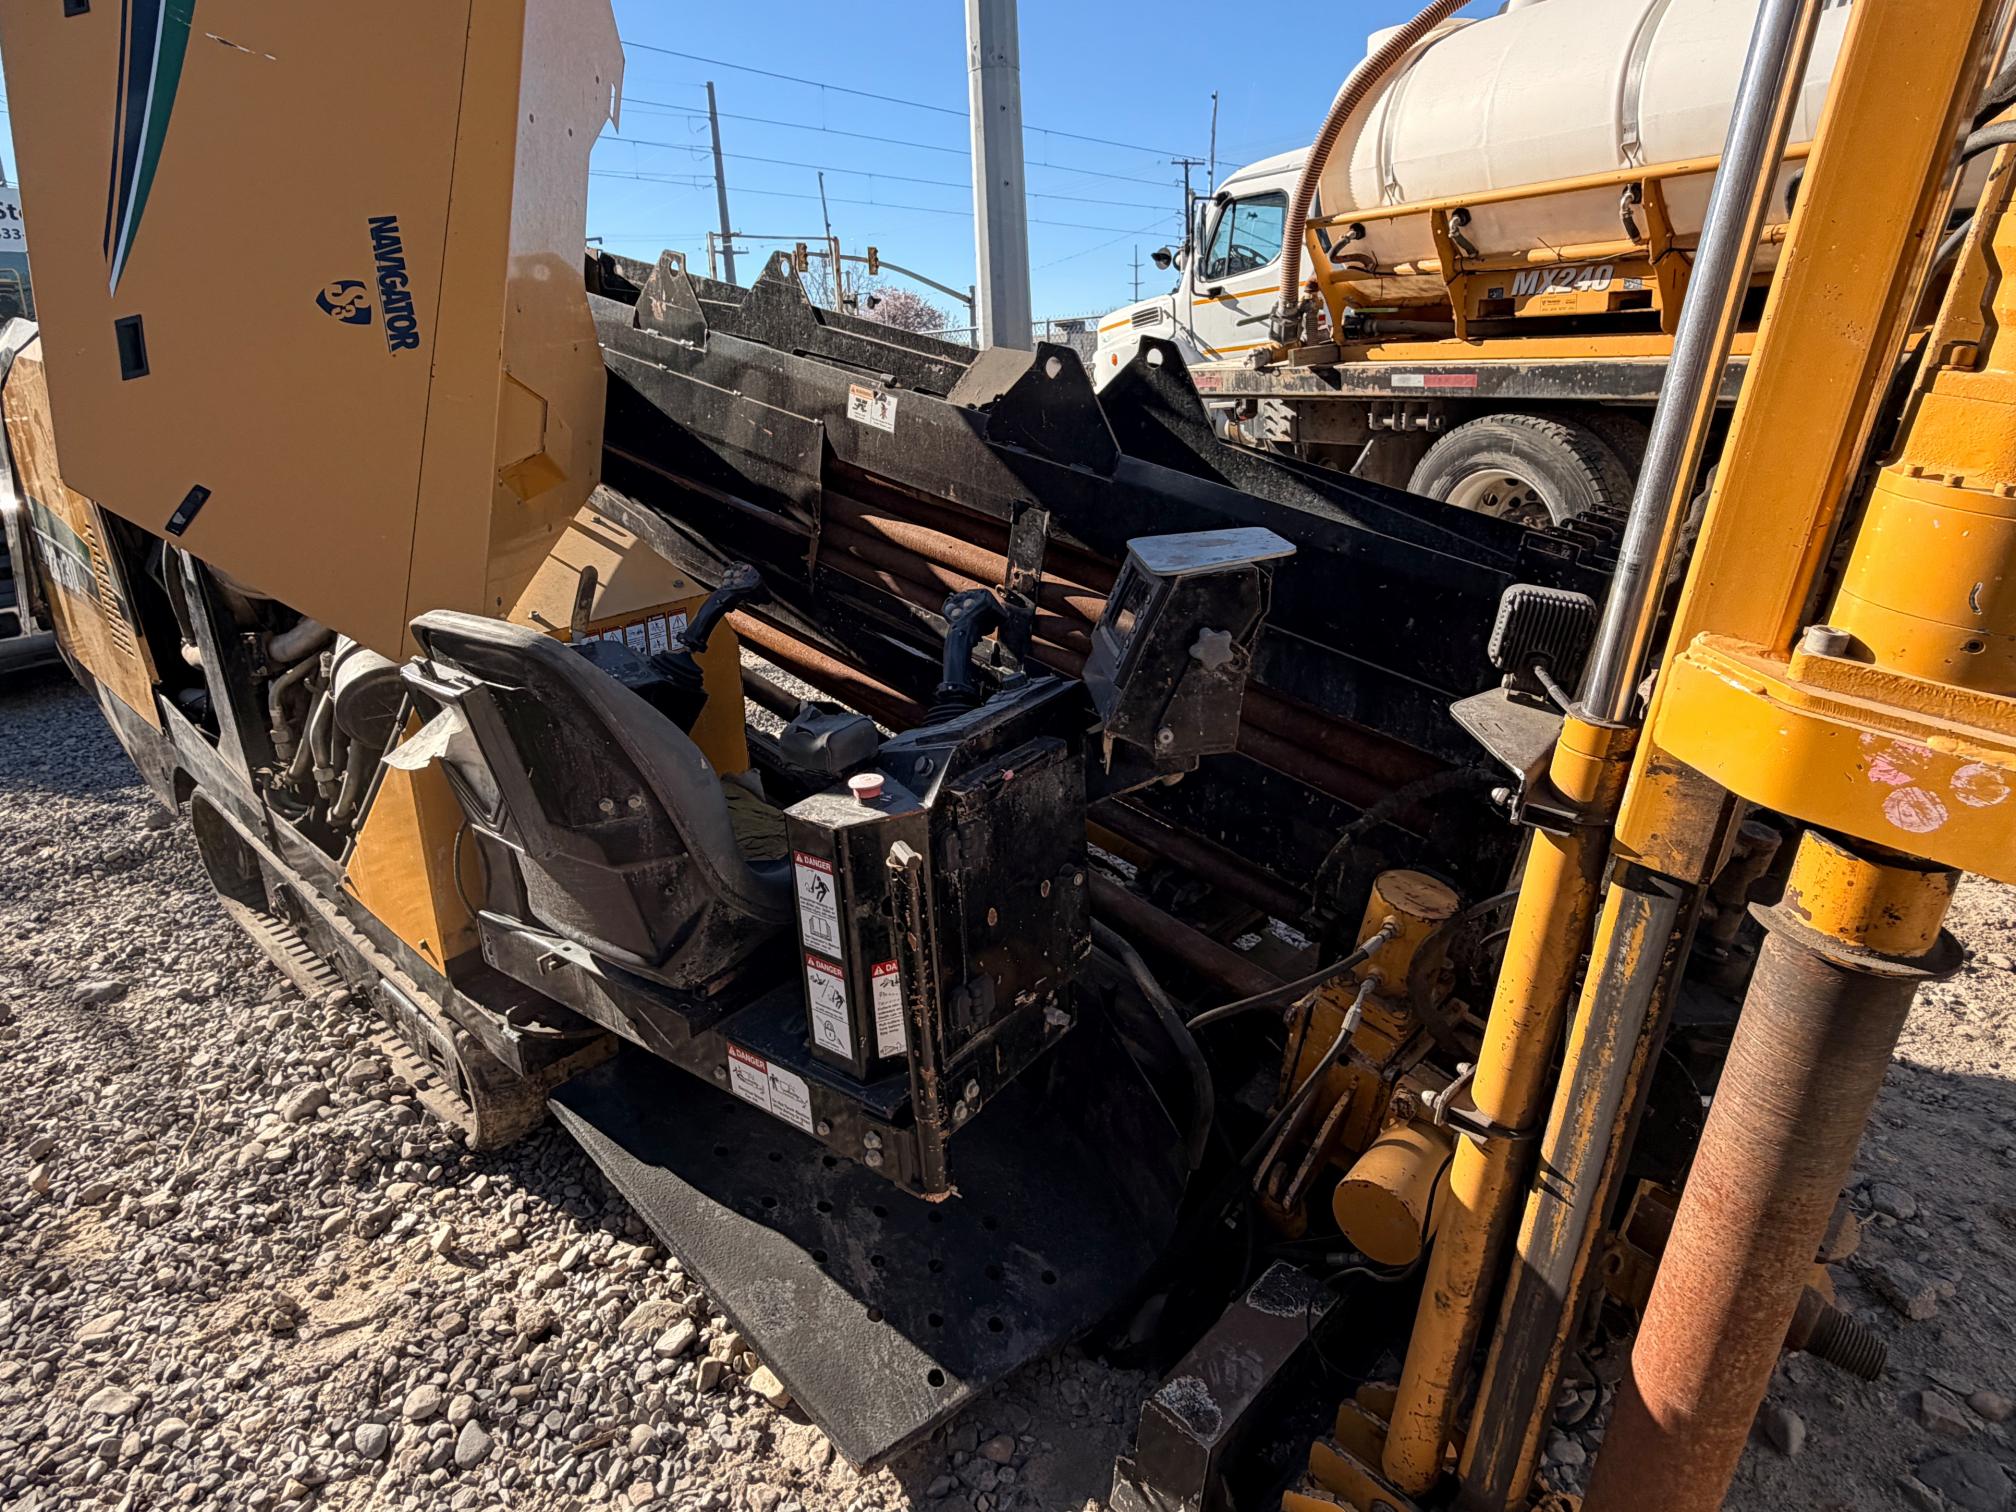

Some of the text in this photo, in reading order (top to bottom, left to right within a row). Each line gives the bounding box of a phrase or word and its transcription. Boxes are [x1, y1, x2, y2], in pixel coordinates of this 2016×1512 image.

[368, 215, 420, 352] NAVIGATOR
[1511, 264, 1614, 297] MX240
[804, 856, 832, 872] DANGER
[816, 960, 842, 977] DANGER
[736, 1048, 766, 1070] DANGER
